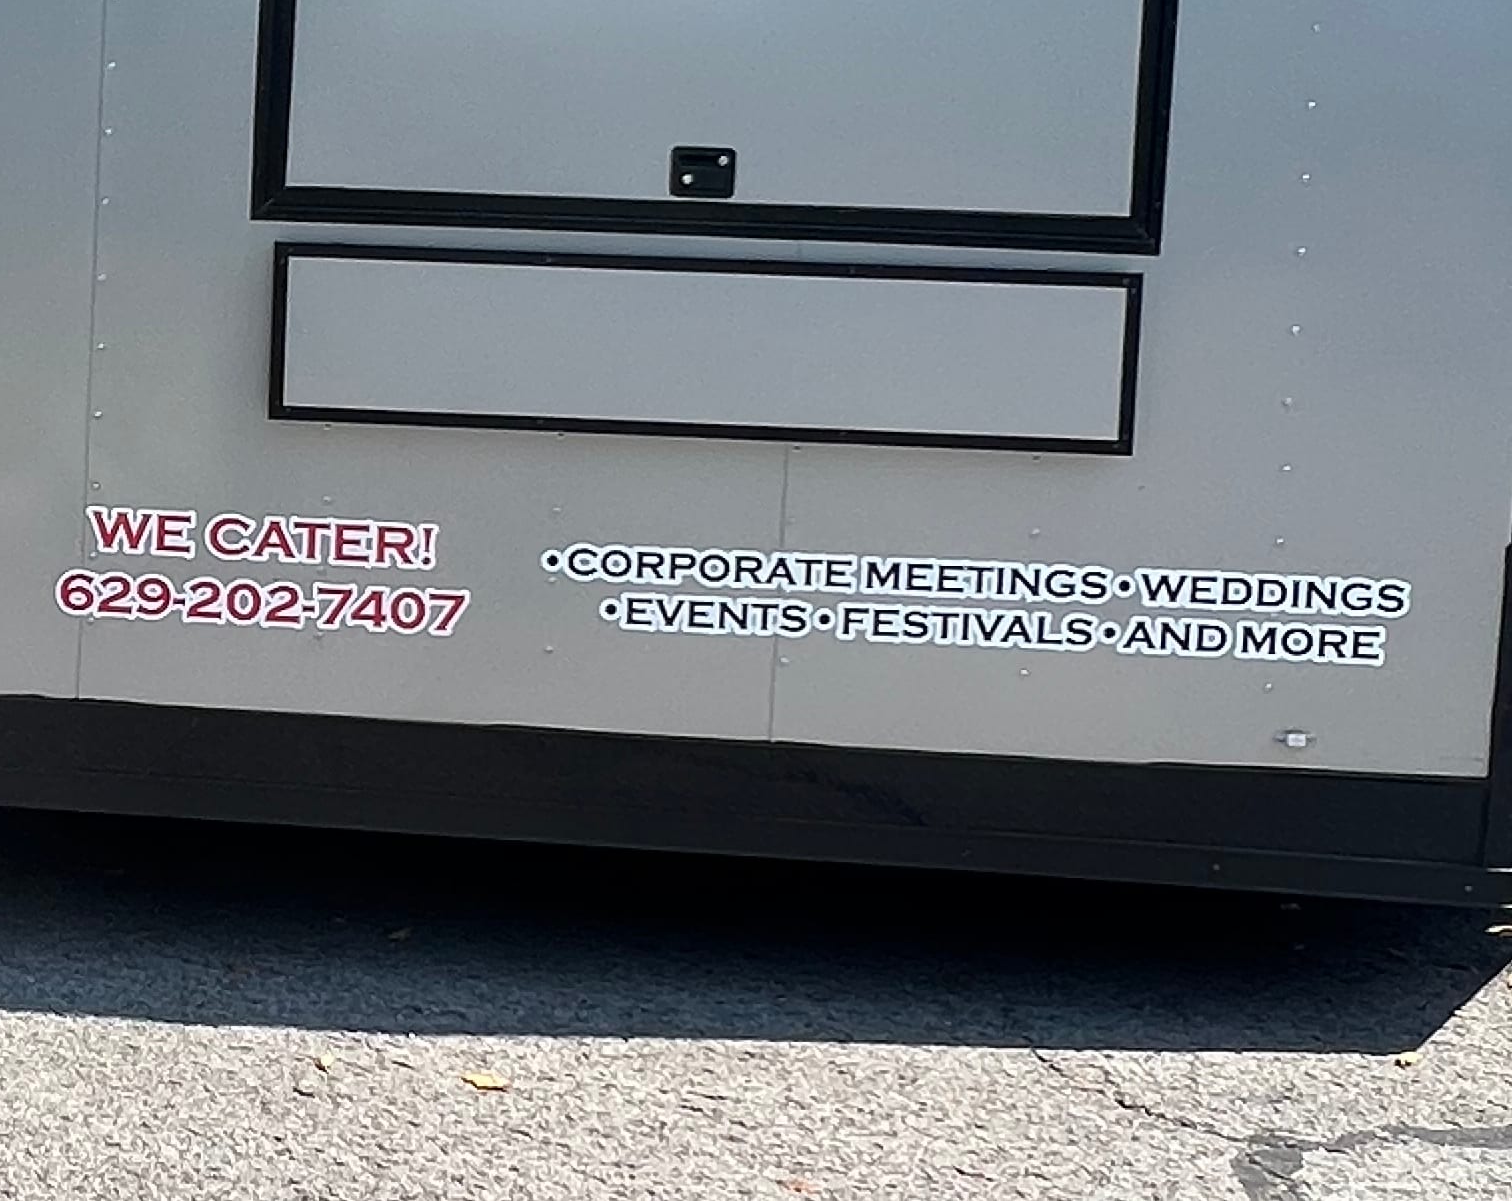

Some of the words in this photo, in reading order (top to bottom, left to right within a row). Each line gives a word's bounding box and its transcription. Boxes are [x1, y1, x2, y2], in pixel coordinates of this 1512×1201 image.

[91, 510, 192, 554] WE
[208, 516, 437, 566] CATER!
[59, 572, 467, 632] 629-202-7407
[1241, 625, 1382, 660] MORE
